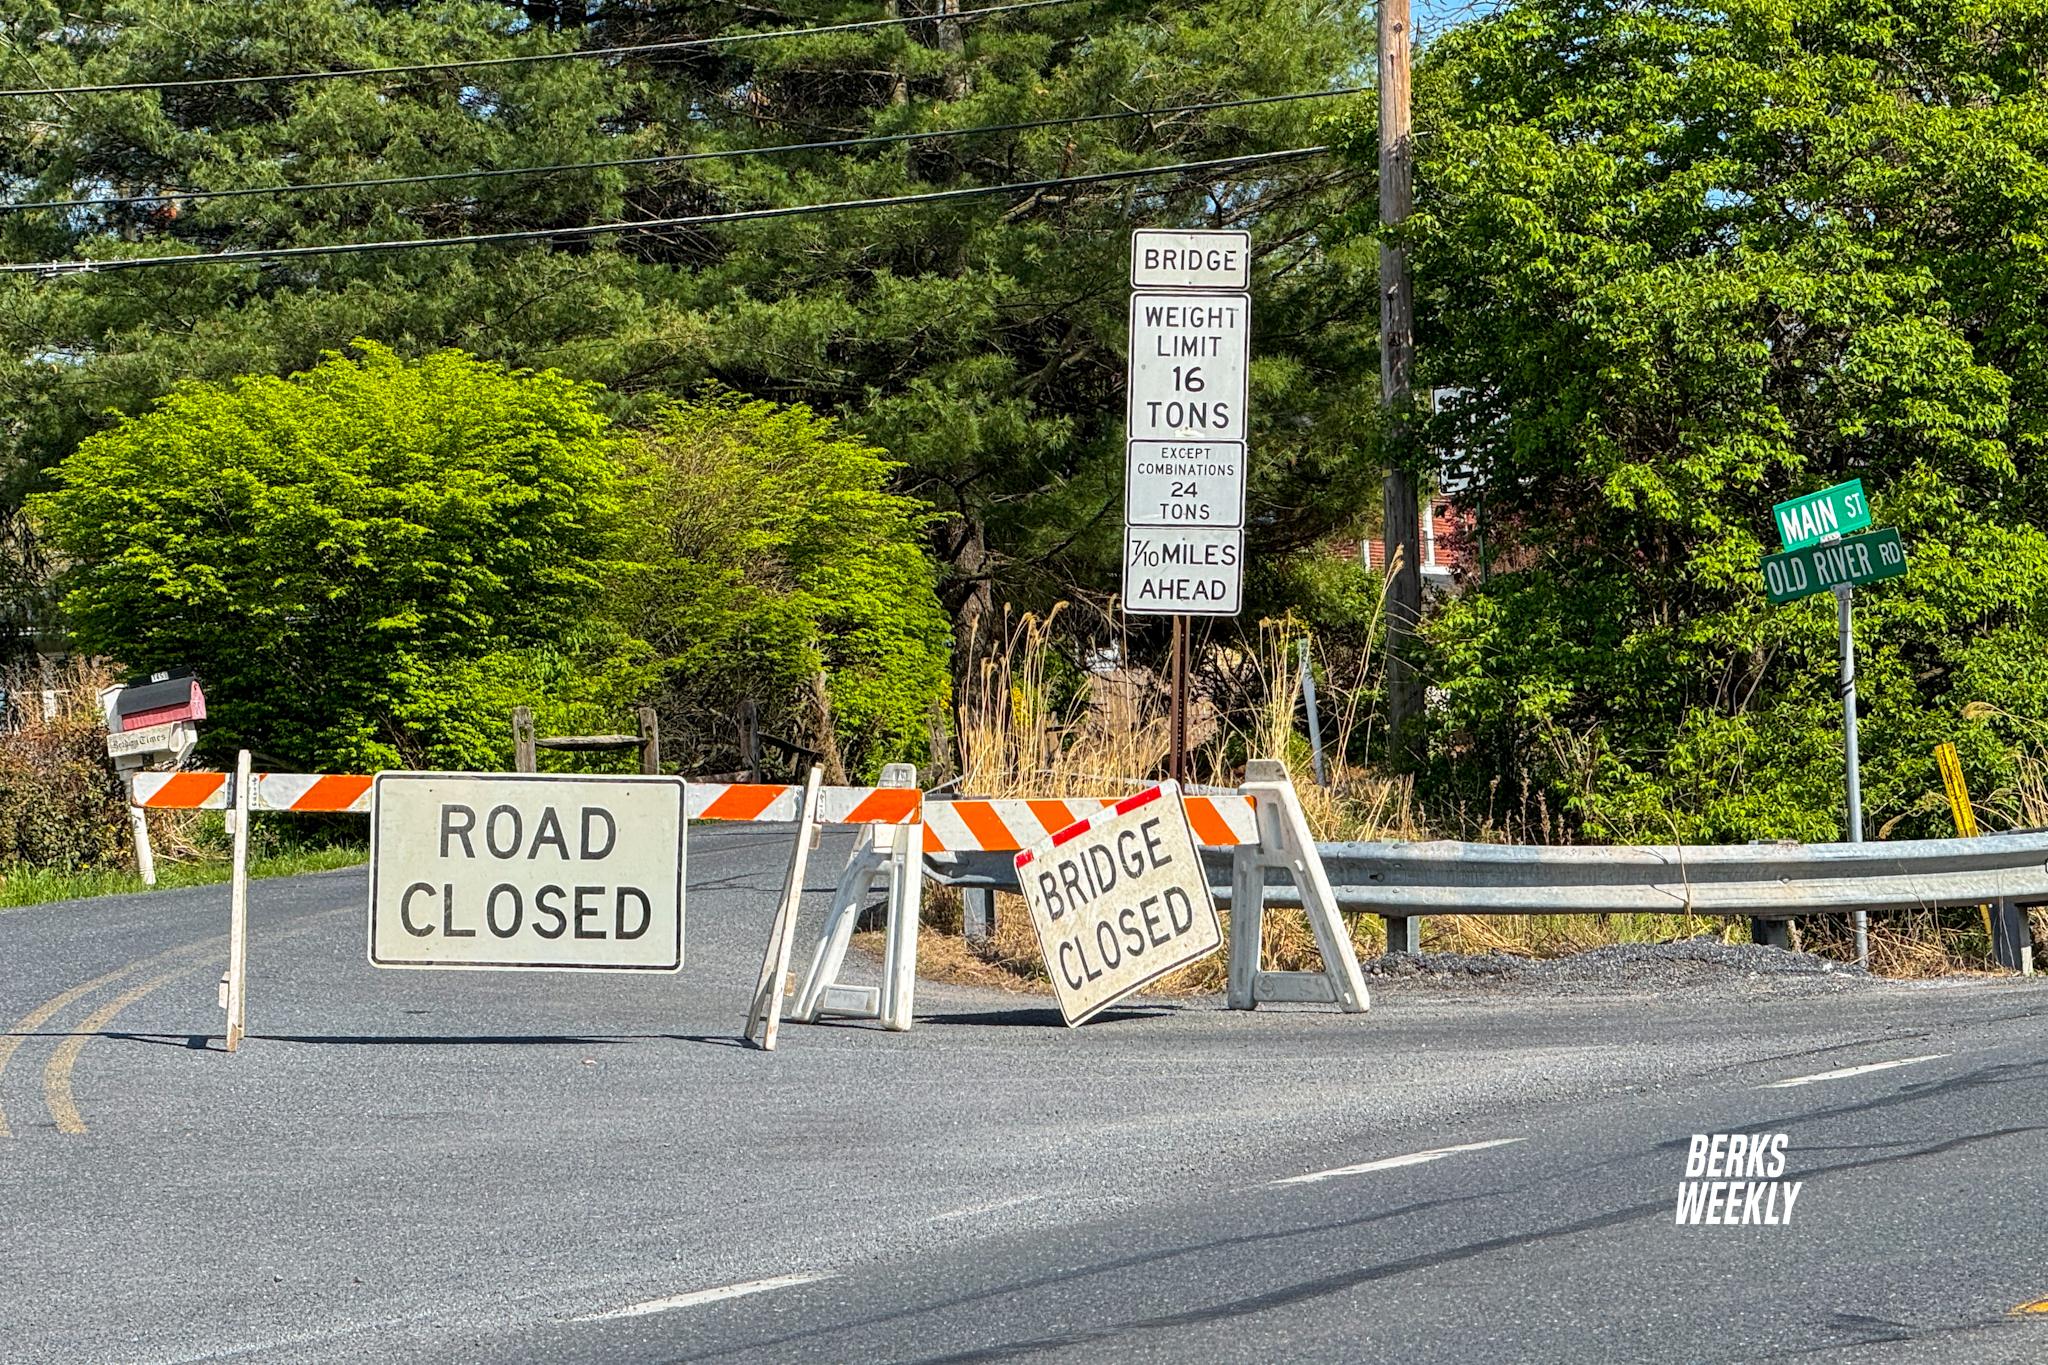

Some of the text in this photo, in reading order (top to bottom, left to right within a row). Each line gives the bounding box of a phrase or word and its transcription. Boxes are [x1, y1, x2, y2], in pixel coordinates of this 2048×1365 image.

[1145, 249, 1237, 272] BRIDGE
[1145, 306, 1239, 328] WEIGHT
[1157, 336, 1222, 357] LIMIT
[1172, 366, 1205, 392] 16
[1147, 402, 1230, 428] TONS
[1161, 447, 1211, 460] EXCEPT
[1137, 462, 1235, 476] COMBINATIONS
[1170, 482, 1199, 498] 24
[1160, 503, 1210, 520] TONS
[1780, 493, 1863, 545] MAIN ST
[1161, 543, 1236, 566] MILES
[1766, 541, 1901, 596] OLD RIVER RD
[1139, 579, 1226, 600] AHEAD
[440, 804, 617, 860] ROAD
[1039, 817, 1173, 923] BRIDGE
[400, 882, 652, 939] CLOSED
[1059, 886, 1193, 991] CLOSED
